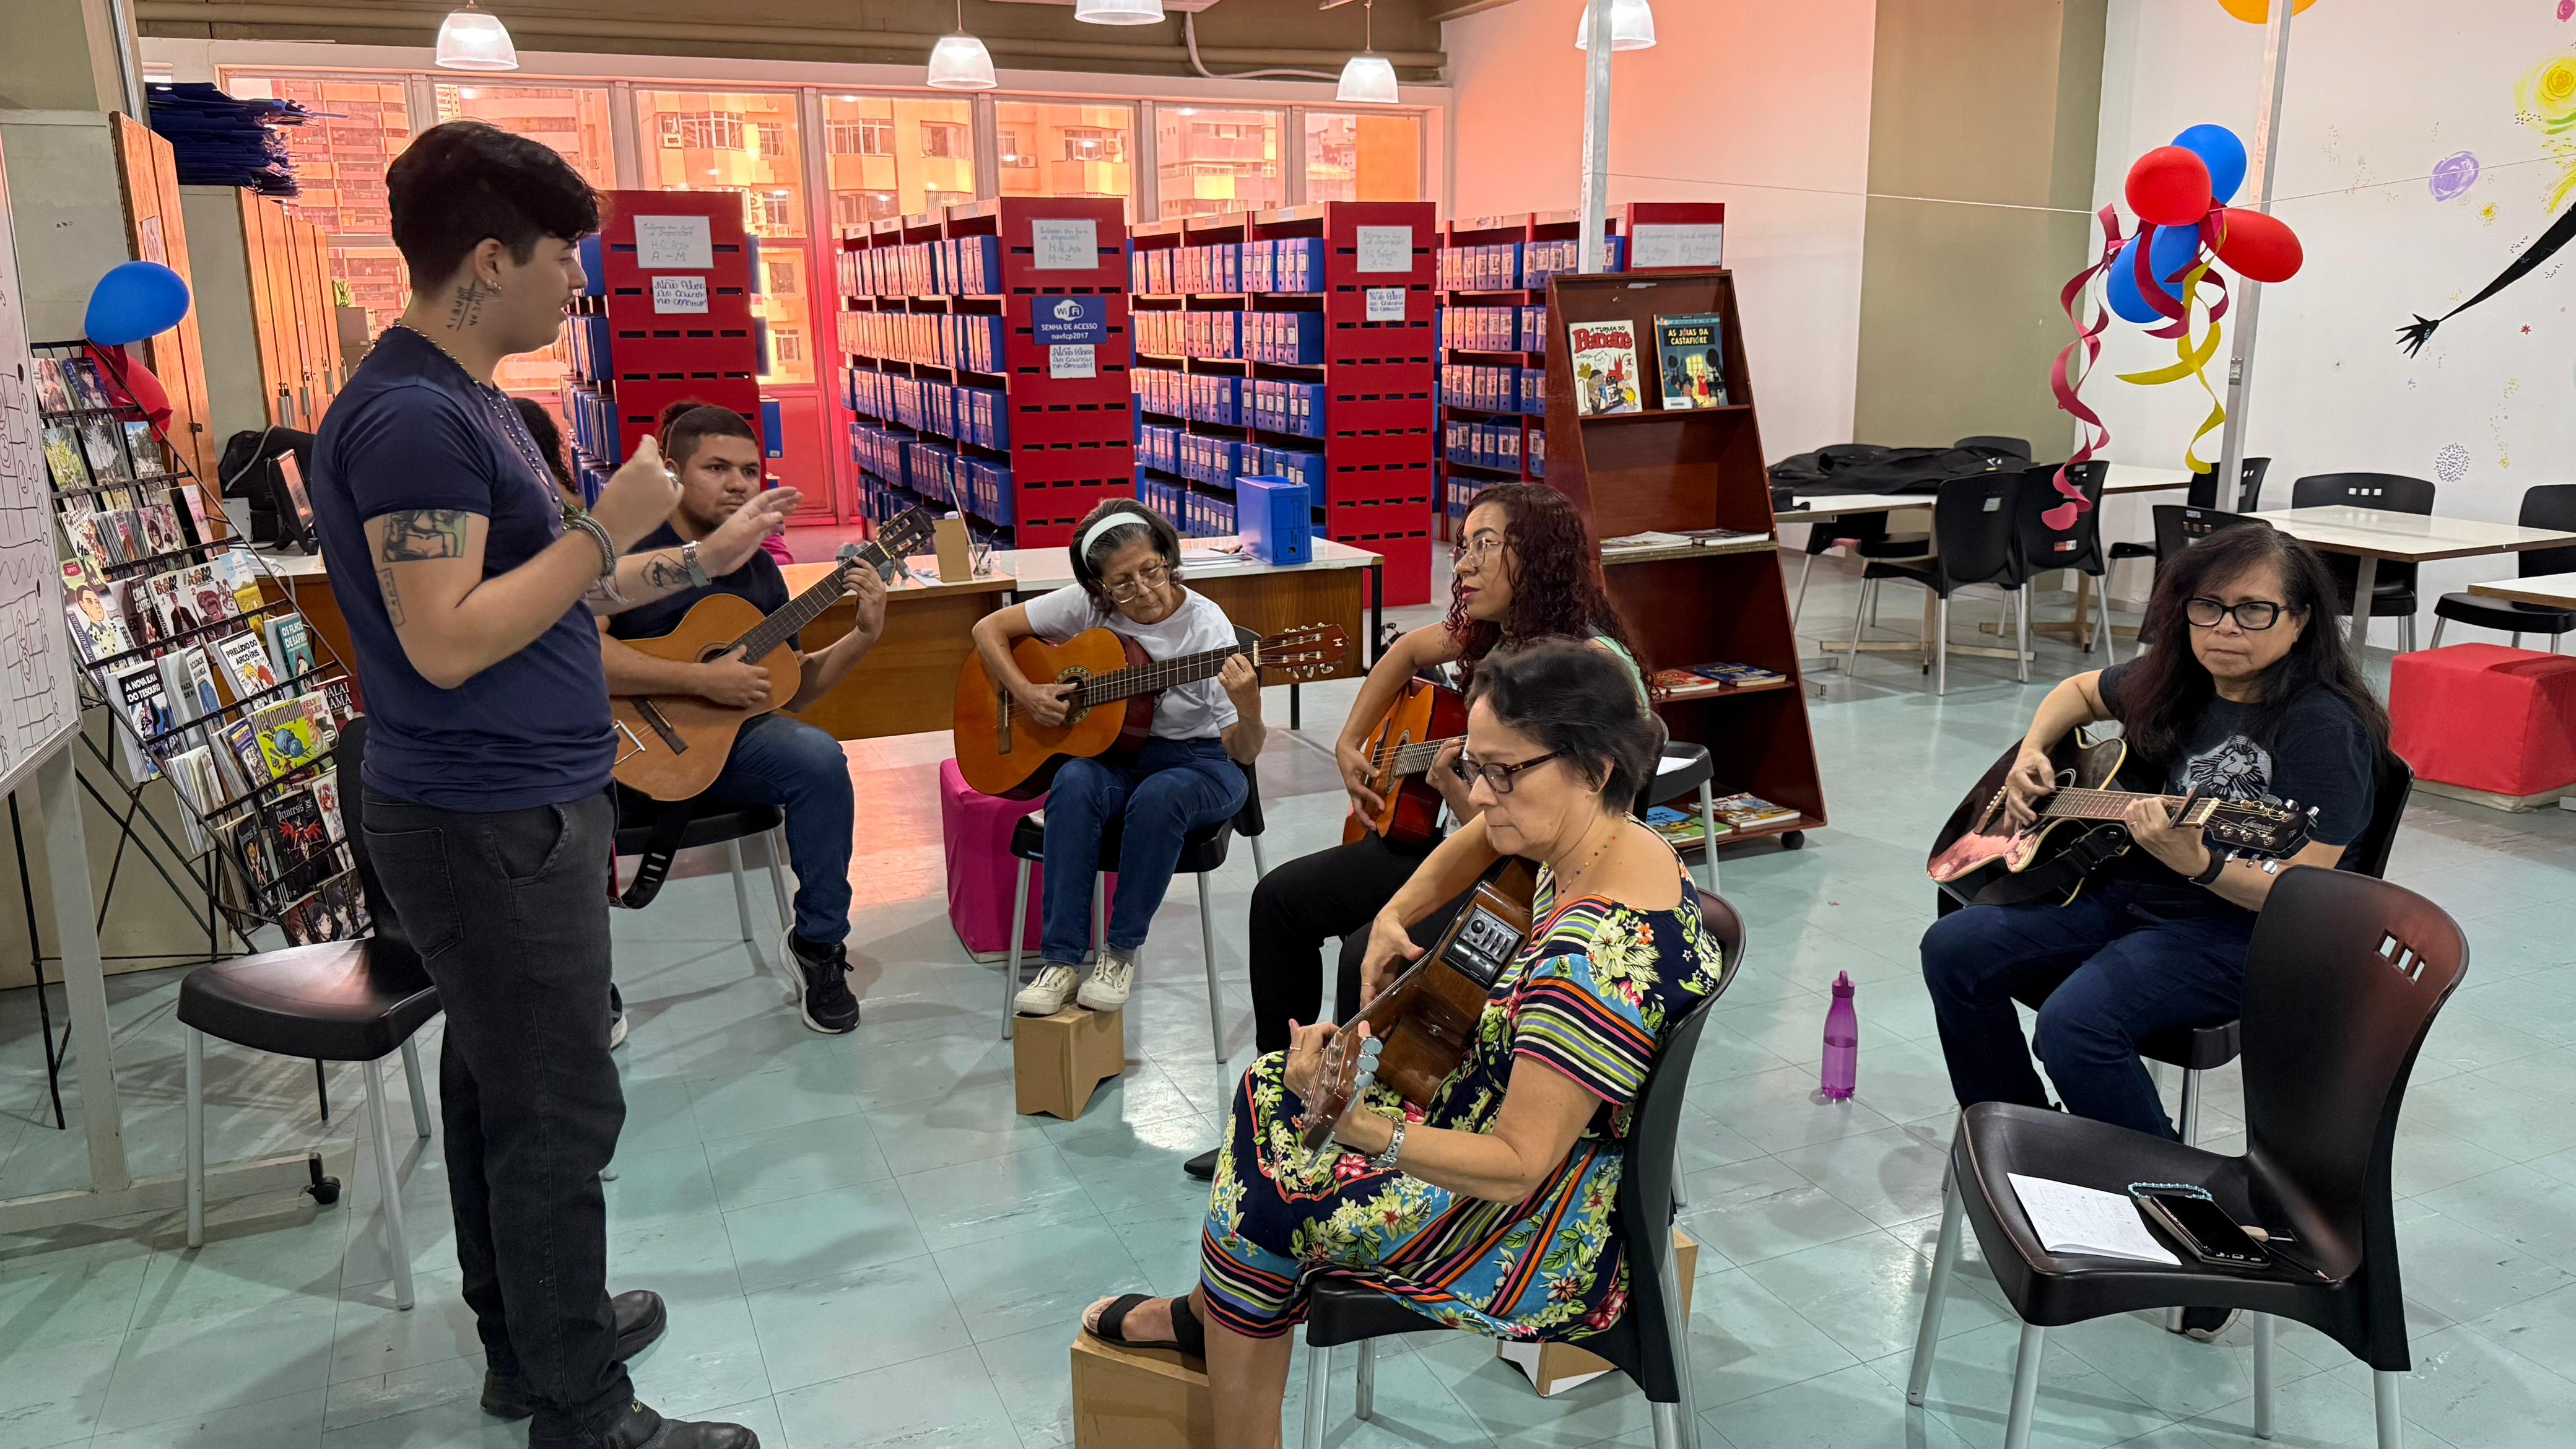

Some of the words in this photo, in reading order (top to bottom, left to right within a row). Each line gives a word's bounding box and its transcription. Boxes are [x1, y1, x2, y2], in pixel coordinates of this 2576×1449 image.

[1668, 329, 1677, 337] AS
[153, 575, 177, 588] SLAM
[154, 581, 178, 596] DUNK
[191, 587, 198, 596] 2
[281, 625, 290, 637] OS
[289, 620, 303, 635] FILHOS
[225, 640, 250, 658] PRELÚDIO
[250, 639, 258, 648] DO
[284, 637, 294, 649] DE
[235, 649, 260, 666] ARCO-ÍRIS
[125, 683, 133, 692] A
[132, 677, 148, 690] NOVA
[146, 672, 158, 684] ILHA
[323, 682, 350, 698] DALAI
[126, 692, 140, 703] DO
[139, 683, 161, 700] TESOURO
[329, 693, 352, 710] AMA
[251, 698, 304, 735] Nekomajin
